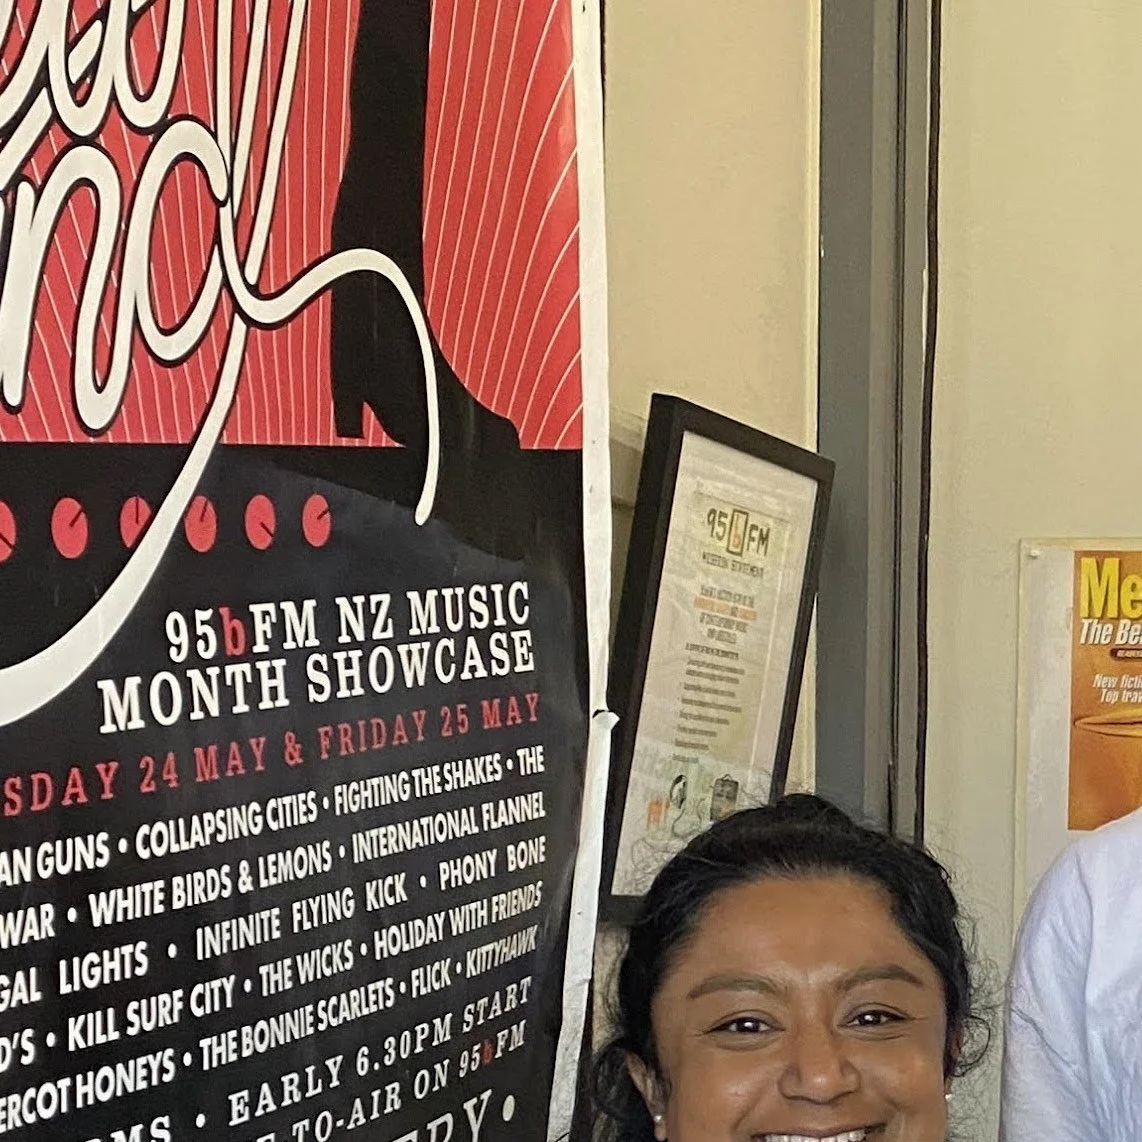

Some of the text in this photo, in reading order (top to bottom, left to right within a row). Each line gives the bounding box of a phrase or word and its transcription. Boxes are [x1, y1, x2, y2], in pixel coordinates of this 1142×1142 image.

[97, 629, 534, 734] MONTH SHOWCASE
[166, 580, 529, 663] 95bFM NZ MUSIC
[1080, 618, 1113, 645] The
[4, 693, 541, 816] SDAY 24 MAY & FRIDAY 25 MAY
[37, 832, 110, 879] GUNS
[136, 802, 263, 860] COLLAPSING
[266, 790, 318, 830] CITIES
[334, 770, 410, 816] FIGHTING
[412, 765, 443, 798] THE
[443, 752, 501, 791] SHAKES
[516, 745, 545, 775] THE
[0, 791, 546, 949] WAR WHITE BIRDS & LEMONS INTERNATIONAL FLANNEL
[59, 941, 149, 995] LIGHTS
[196, 907, 281, 961] INFINITE
[292, 887, 355, 933] FLYING
[365, 872, 408, 911] KICK
[439, 848, 497, 890] PHONY
[507, 835, 546, 873] BONE
[68, 1007, 120, 1051] KILL
[126, 989, 183, 1036] SURF
[190, 974, 235, 1017] CITY
[259, 957, 292, 997] THE
[297, 938, 354, 985] WICKS
[374, 911, 446, 961] HOLIDAY
[449, 898, 488, 936] WITH
[491, 880, 542, 923] FRIENDS
[76, 1048, 175, 1108] HONEYS
[199, 1029, 237, 1071] THE
[241, 1003, 314, 1058] BONNIE
[317, 977, 395, 1031] SCARLETS
[411, 957, 451, 998] FLICK
[465, 924, 539, 979] KITTYHAWK
[228, 1055, 343, 1126] EARLY
[357, 1013, 452, 1076] 6.30PM
[462, 976, 532, 1033] START
[414, 1059, 450, 1100] ON
[459, 1020, 527, 1078] 95bFM
